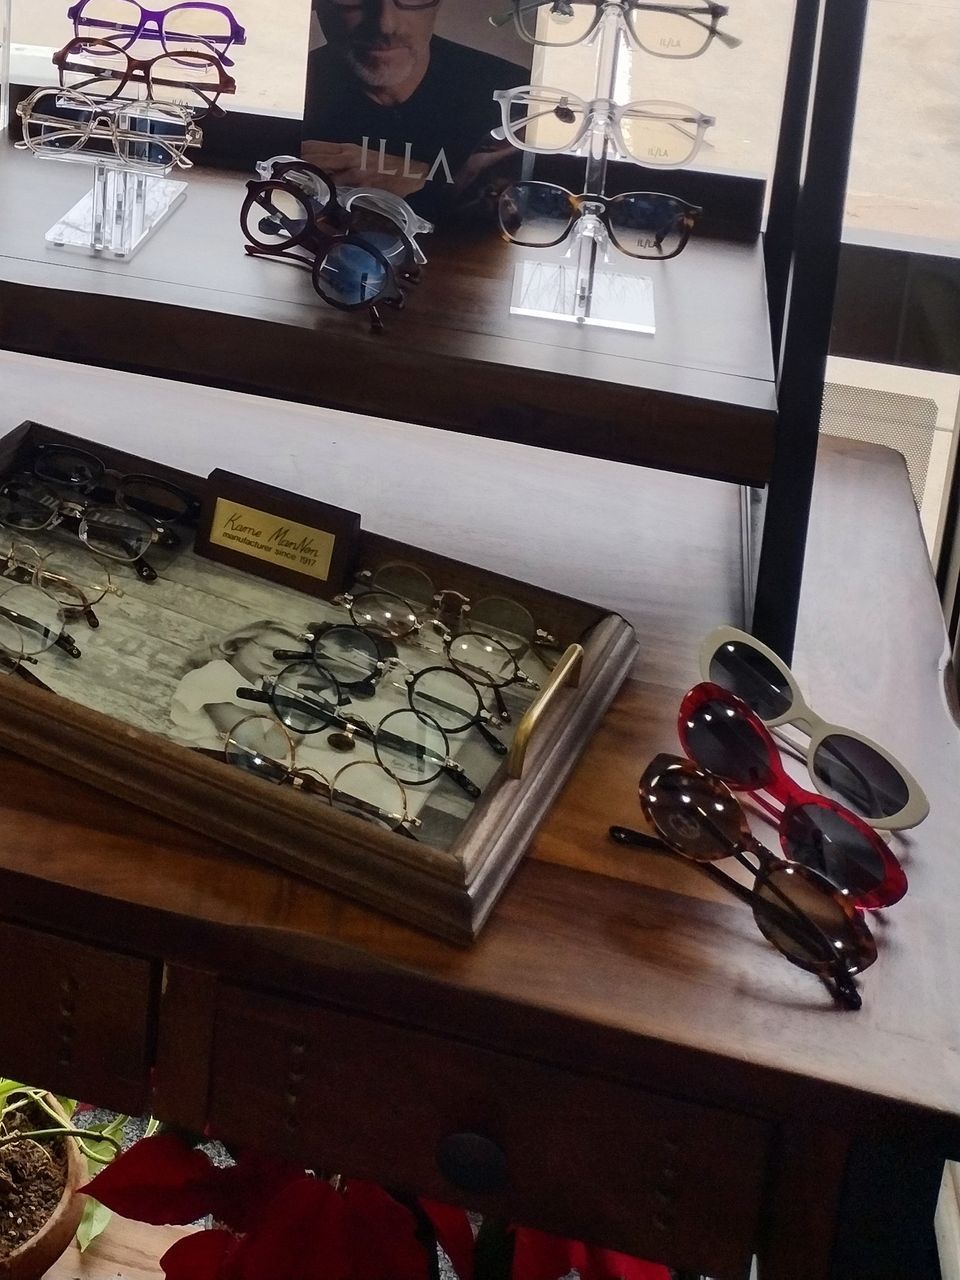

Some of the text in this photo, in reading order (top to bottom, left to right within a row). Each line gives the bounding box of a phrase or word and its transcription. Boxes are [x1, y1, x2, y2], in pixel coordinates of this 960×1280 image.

[360, 135, 455, 184] ILLA
[222, 531, 318, 568] manufacturer since 1917
